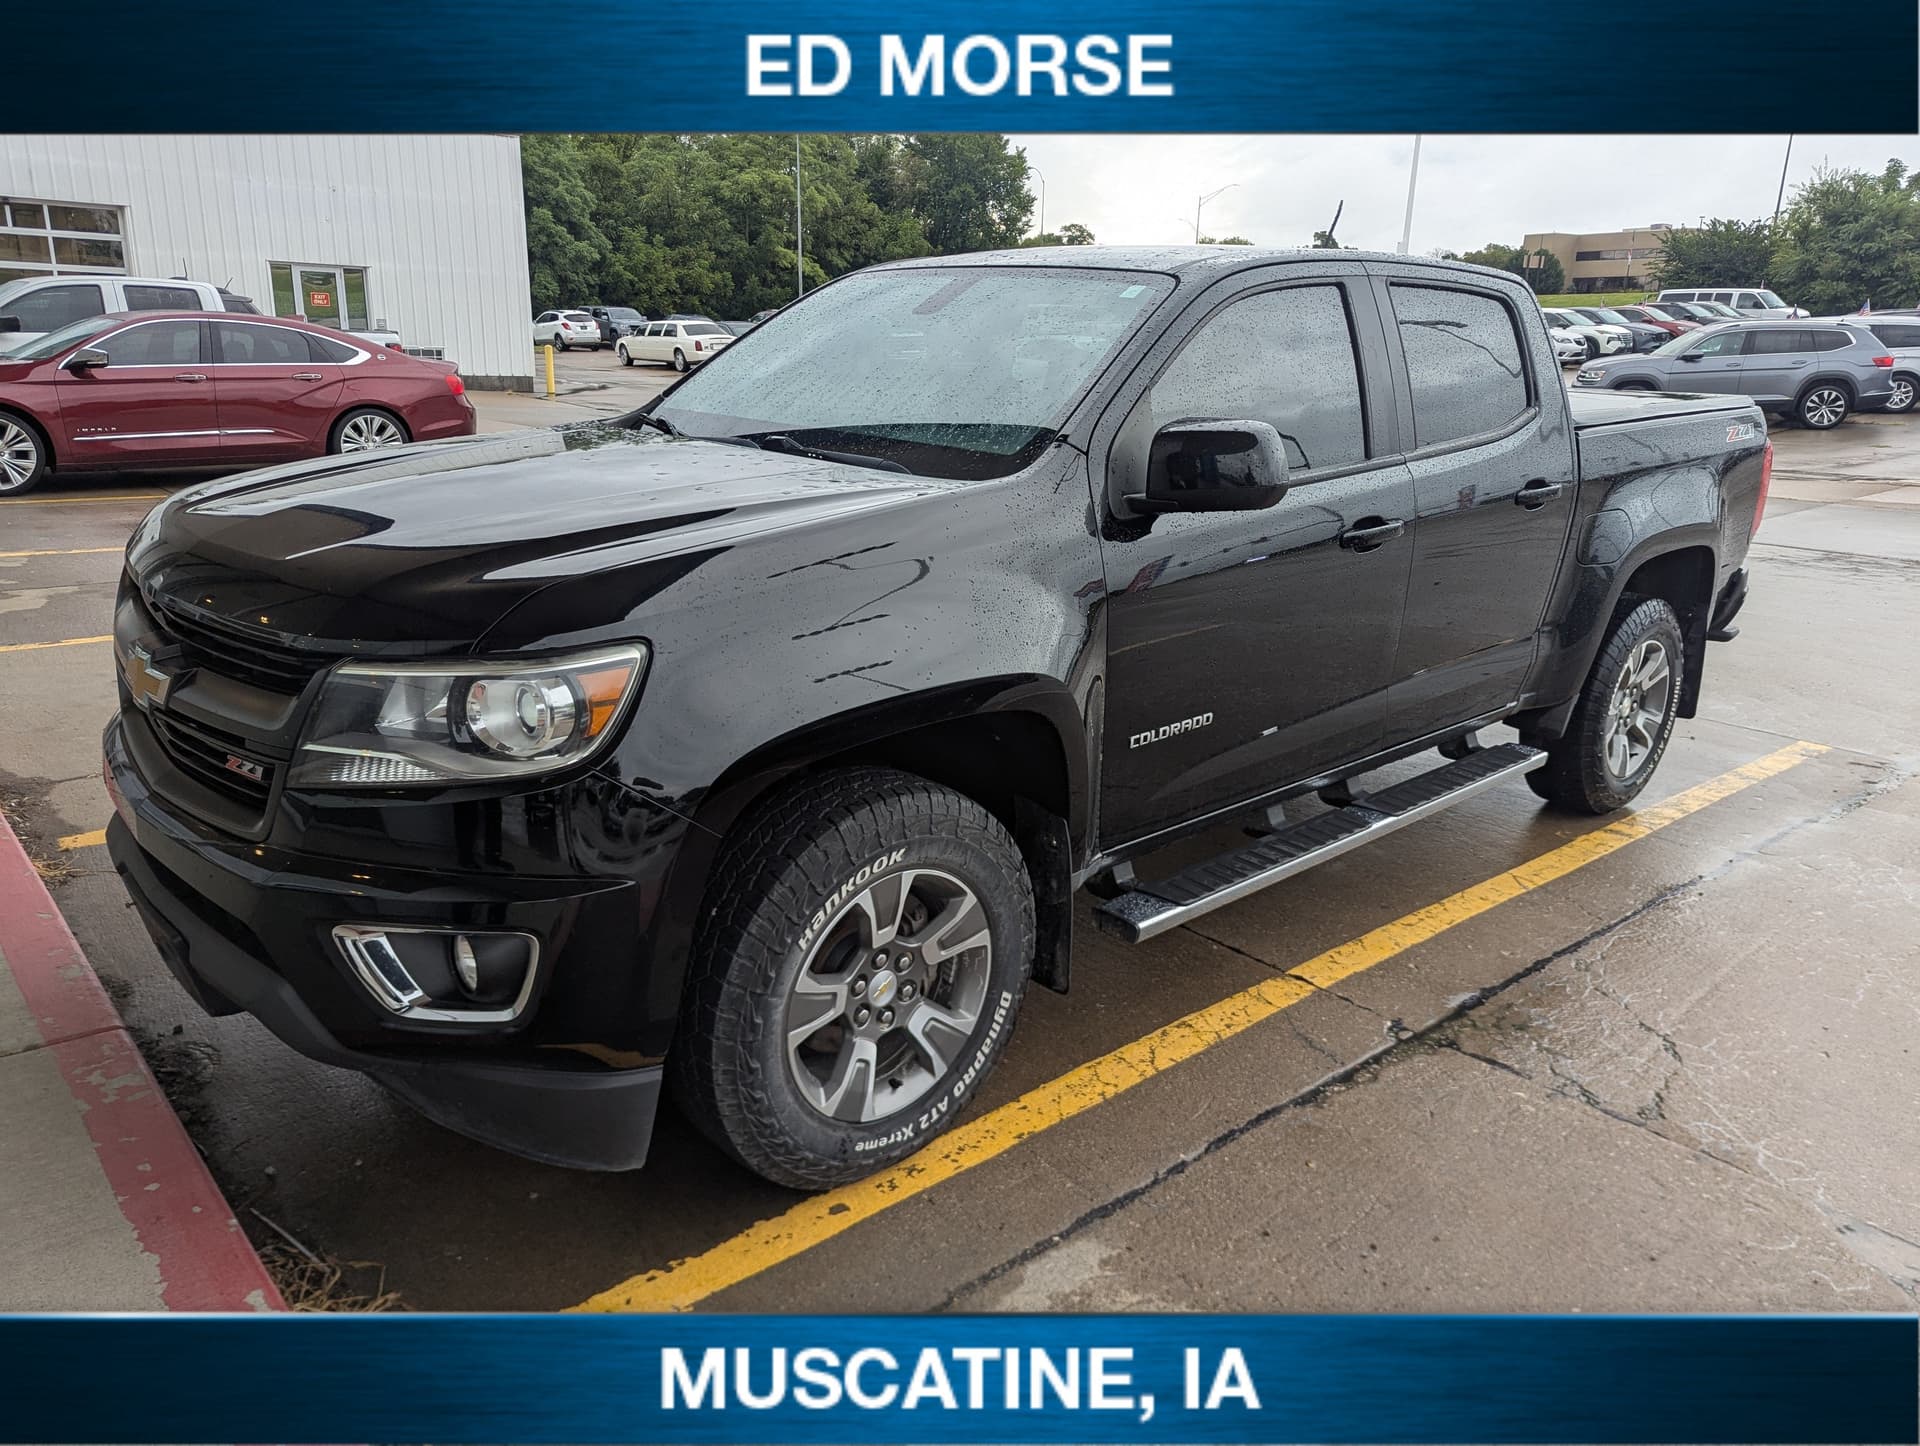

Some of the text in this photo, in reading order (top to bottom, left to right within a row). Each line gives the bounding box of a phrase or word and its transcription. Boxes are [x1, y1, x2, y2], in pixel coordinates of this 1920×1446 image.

[1726, 422, 1755, 443] Z71
[1129, 712, 1214, 749] COLORADO
[224, 754, 264, 782] Z71
[918, 1095, 949, 1129] AT2
[854, 1123, 915, 1152] Xtreme
